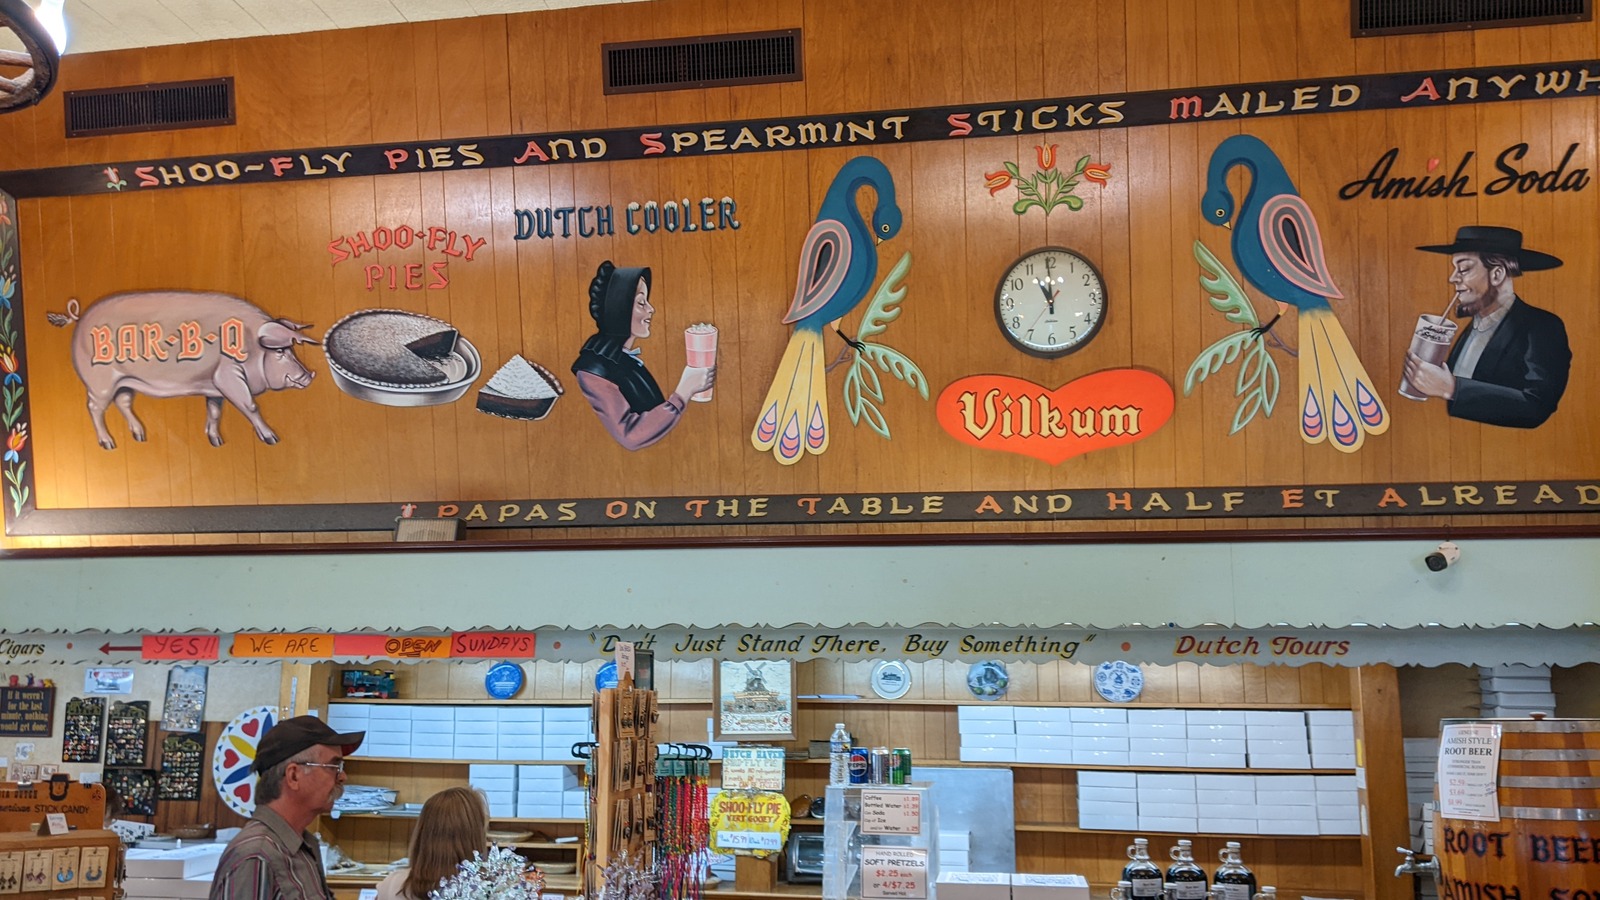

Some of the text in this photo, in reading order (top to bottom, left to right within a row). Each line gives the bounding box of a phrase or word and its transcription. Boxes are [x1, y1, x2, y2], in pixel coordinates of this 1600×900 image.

[384, 144, 485, 170] PIES
[513, 137, 607, 164] AND
[640, 116, 910, 156] SPEARMINT
[948, 101, 1127, 137] STICKS
[1169, 83, 1361, 119] MAILED
[1339, 142, 1591, 200] Amish Soda
[514, 196, 741, 240] DUTCH COOLER
[1025, 263, 1034, 276] 11
[1045, 257, 1056, 269] 12
[364, 262, 449, 291] PIES
[1082, 274, 1090, 286] 2
[1011, 278, 1024, 291] 10
[1006, 298, 1014, 311] 9
[1089, 292, 1097, 306] 3
[1012, 316, 1020, 329] 8
[1084, 312, 1092, 324] 4
[1027, 329, 1034, 340] 7
[1048, 333, 1056, 345] 6
[1069, 326, 1077, 339] 5
[957, 388, 1143, 441] Vilkum
[437, 484, 1600, 522] PAPAS ON THE TABLE AND HALF ET ALREAD
[0, 638, 45, 658] Cigars
[151, 637, 217, 658] YES!!
[249, 637, 320, 653] WE ARE
[385, 638, 443, 655] OPEN
[456, 634, 531, 654] SUNDAYS
[589, 632, 657, 652] "Dn't
[674, 634, 726, 653] Just
[738, 633, 803, 653] Stand
[905, 634, 949, 658] Buy
[1177, 635, 1351, 656] Dutch Tours
[19, 701, 29, 710] the
[1447, 737, 1492, 745] AMISH STYLE
[1444, 747, 1492, 756] ROOT BEER
[34, 805, 59, 813] STICK
[61, 805, 90, 814] CANDY
[719, 801, 782, 814] SHOO-FLY PIE
[1443, 826, 1509, 858] ROOT
[864, 858, 925, 867] SOFT PRETZELS
[875, 869, 899, 877] $2.25
